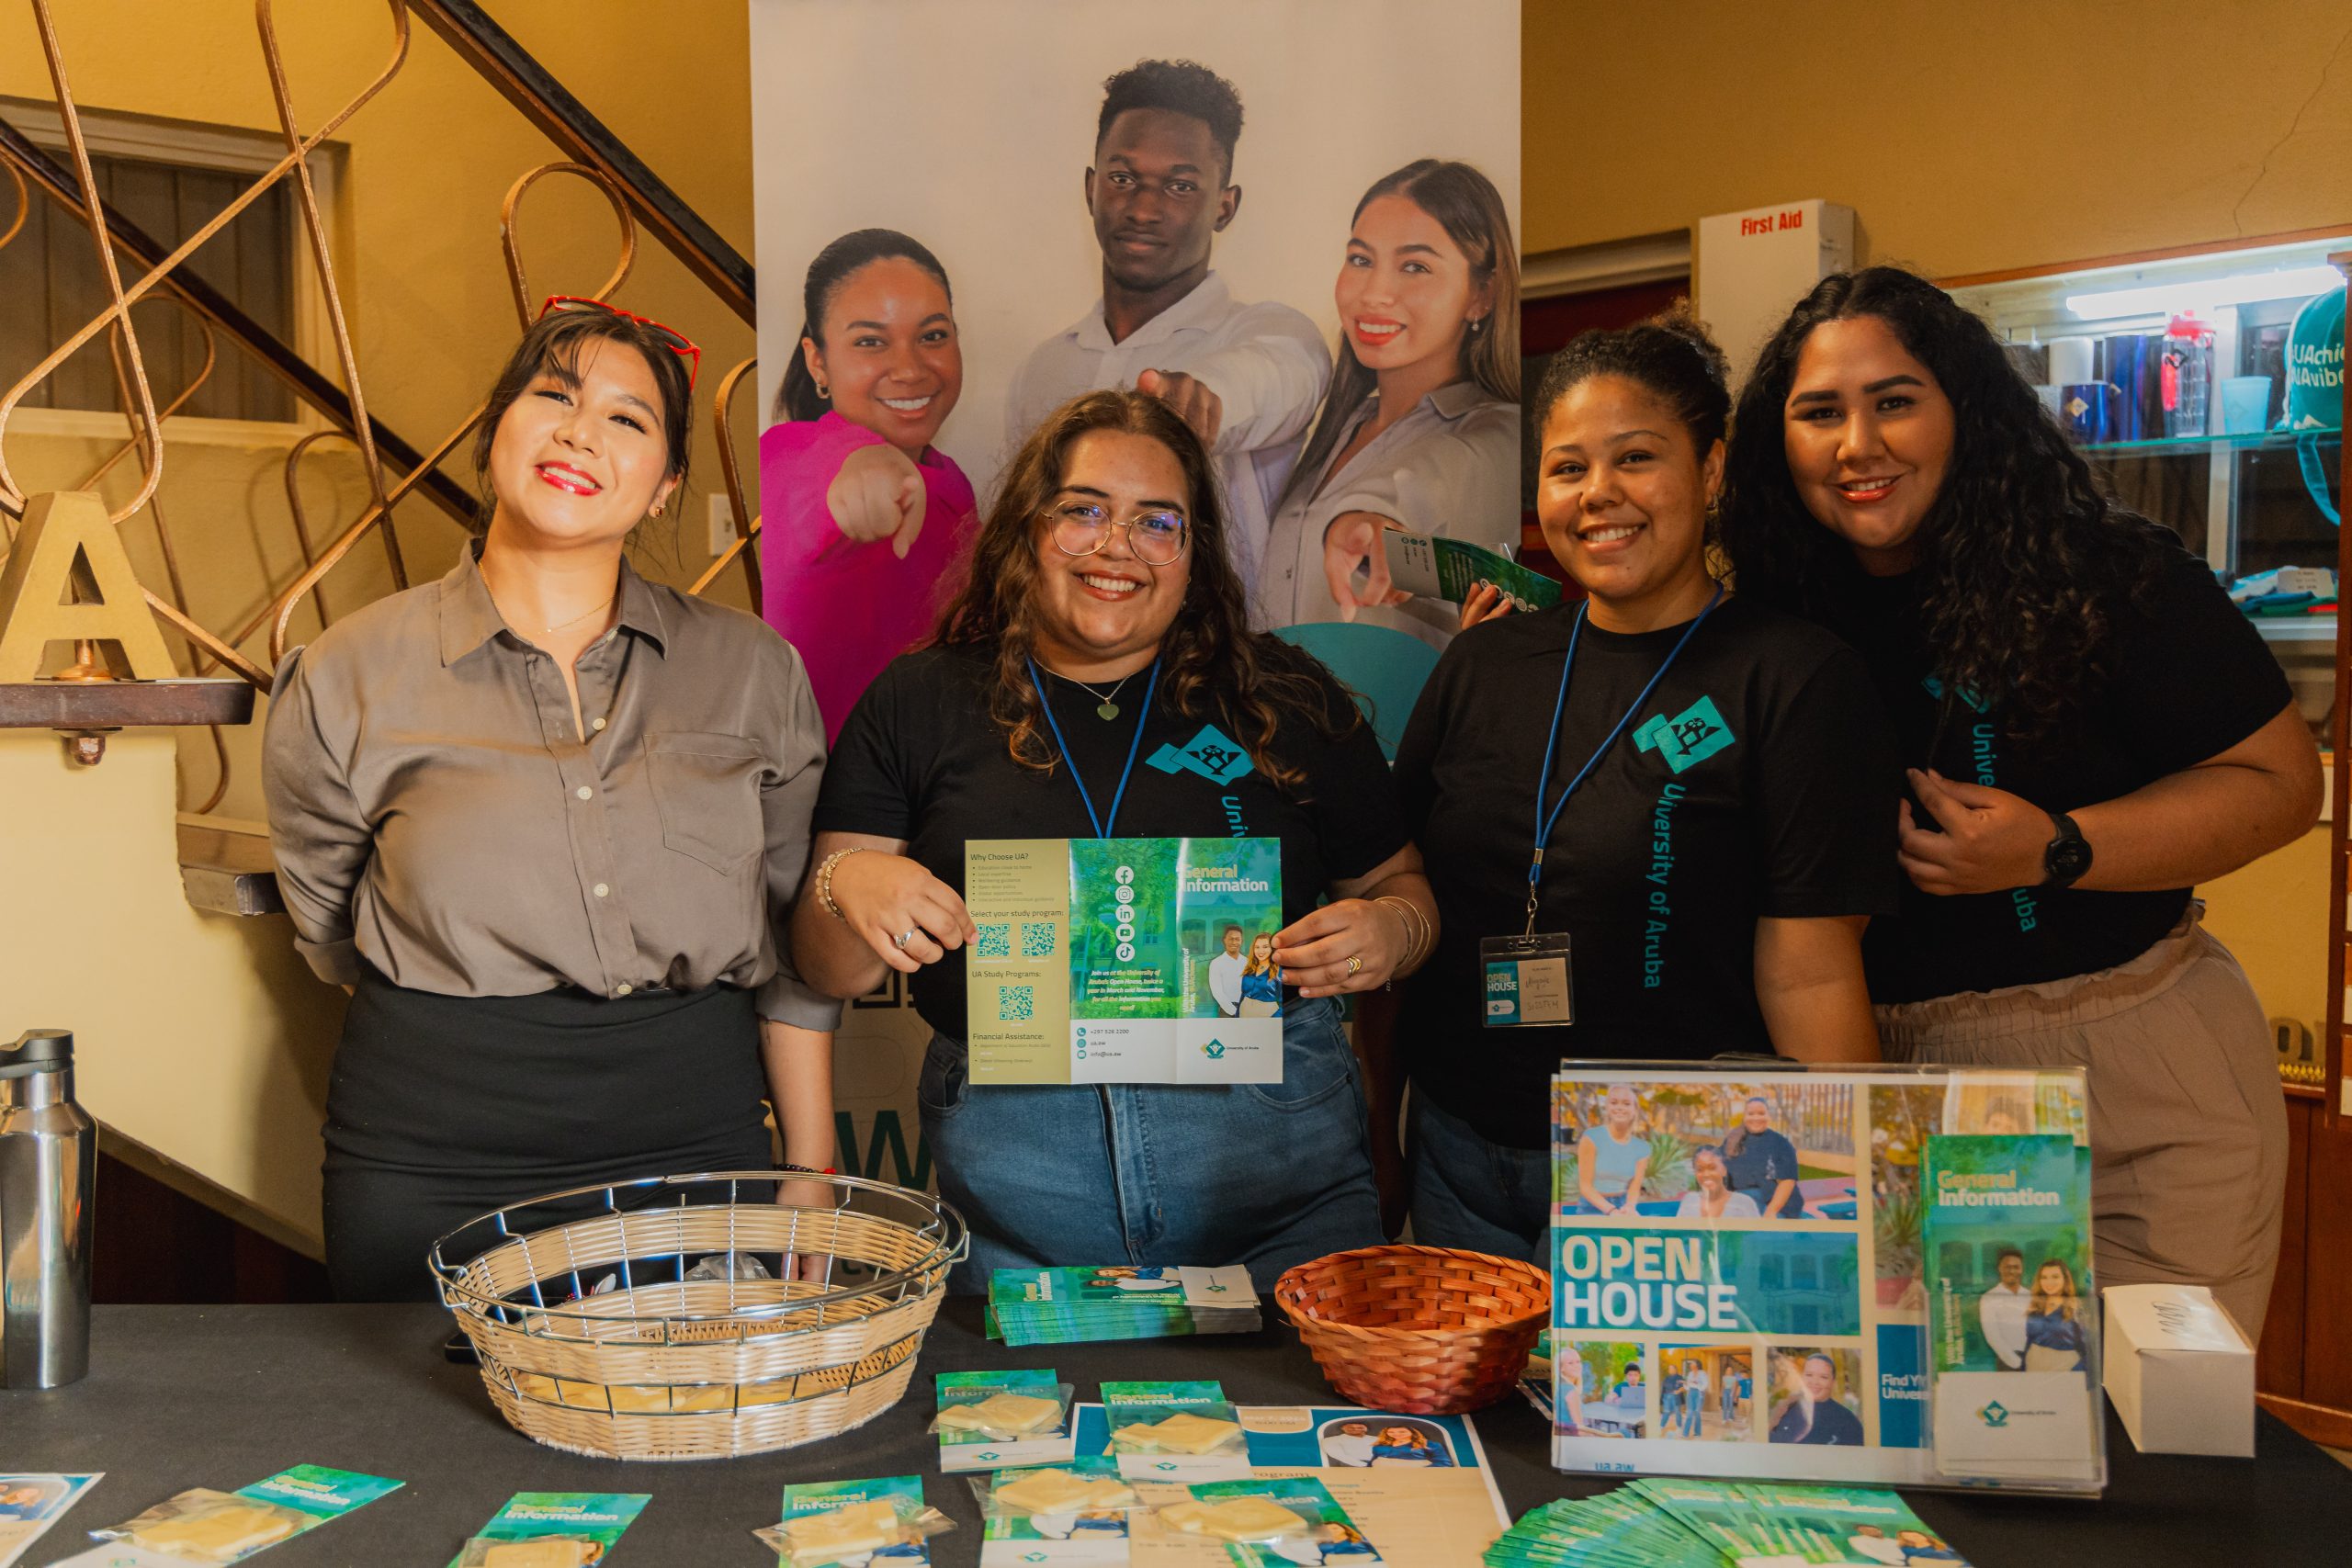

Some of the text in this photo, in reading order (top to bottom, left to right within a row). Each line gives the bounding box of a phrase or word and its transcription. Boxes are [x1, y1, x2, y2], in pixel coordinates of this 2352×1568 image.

[1741, 209, 1803, 236] First Aid
[0, 491, 181, 681] A
[1973, 724, 1996, 786] Unive
[1182, 864, 1238, 879] General
[1182, 878, 1268, 892] Information
[1649, 891, 1670, 915] of
[2012, 888, 2037, 932] uba
[1033, 910, 1064, 919] program:
[1645, 919, 1665, 987] Aruba
[1005, 971, 1042, 979] Programs:
[1487, 973, 1511, 983] OPEN
[1487, 981, 1518, 992] HOUSE
[1938, 1169, 2017, 1189] General
[1939, 1188, 2060, 1206] Information
[1563, 1235, 1702, 1280] OPEN
[1039, 1271, 1053, 1302] Information
[1565, 1281, 1738, 1328] HOUSE
[1882, 1374, 1909, 1386] Find
[1110, 1393, 1174, 1401] General
[1111, 1397, 1212, 1405] Information
[793, 1492, 867, 1503] General
[504, 1510, 618, 1521] Information
